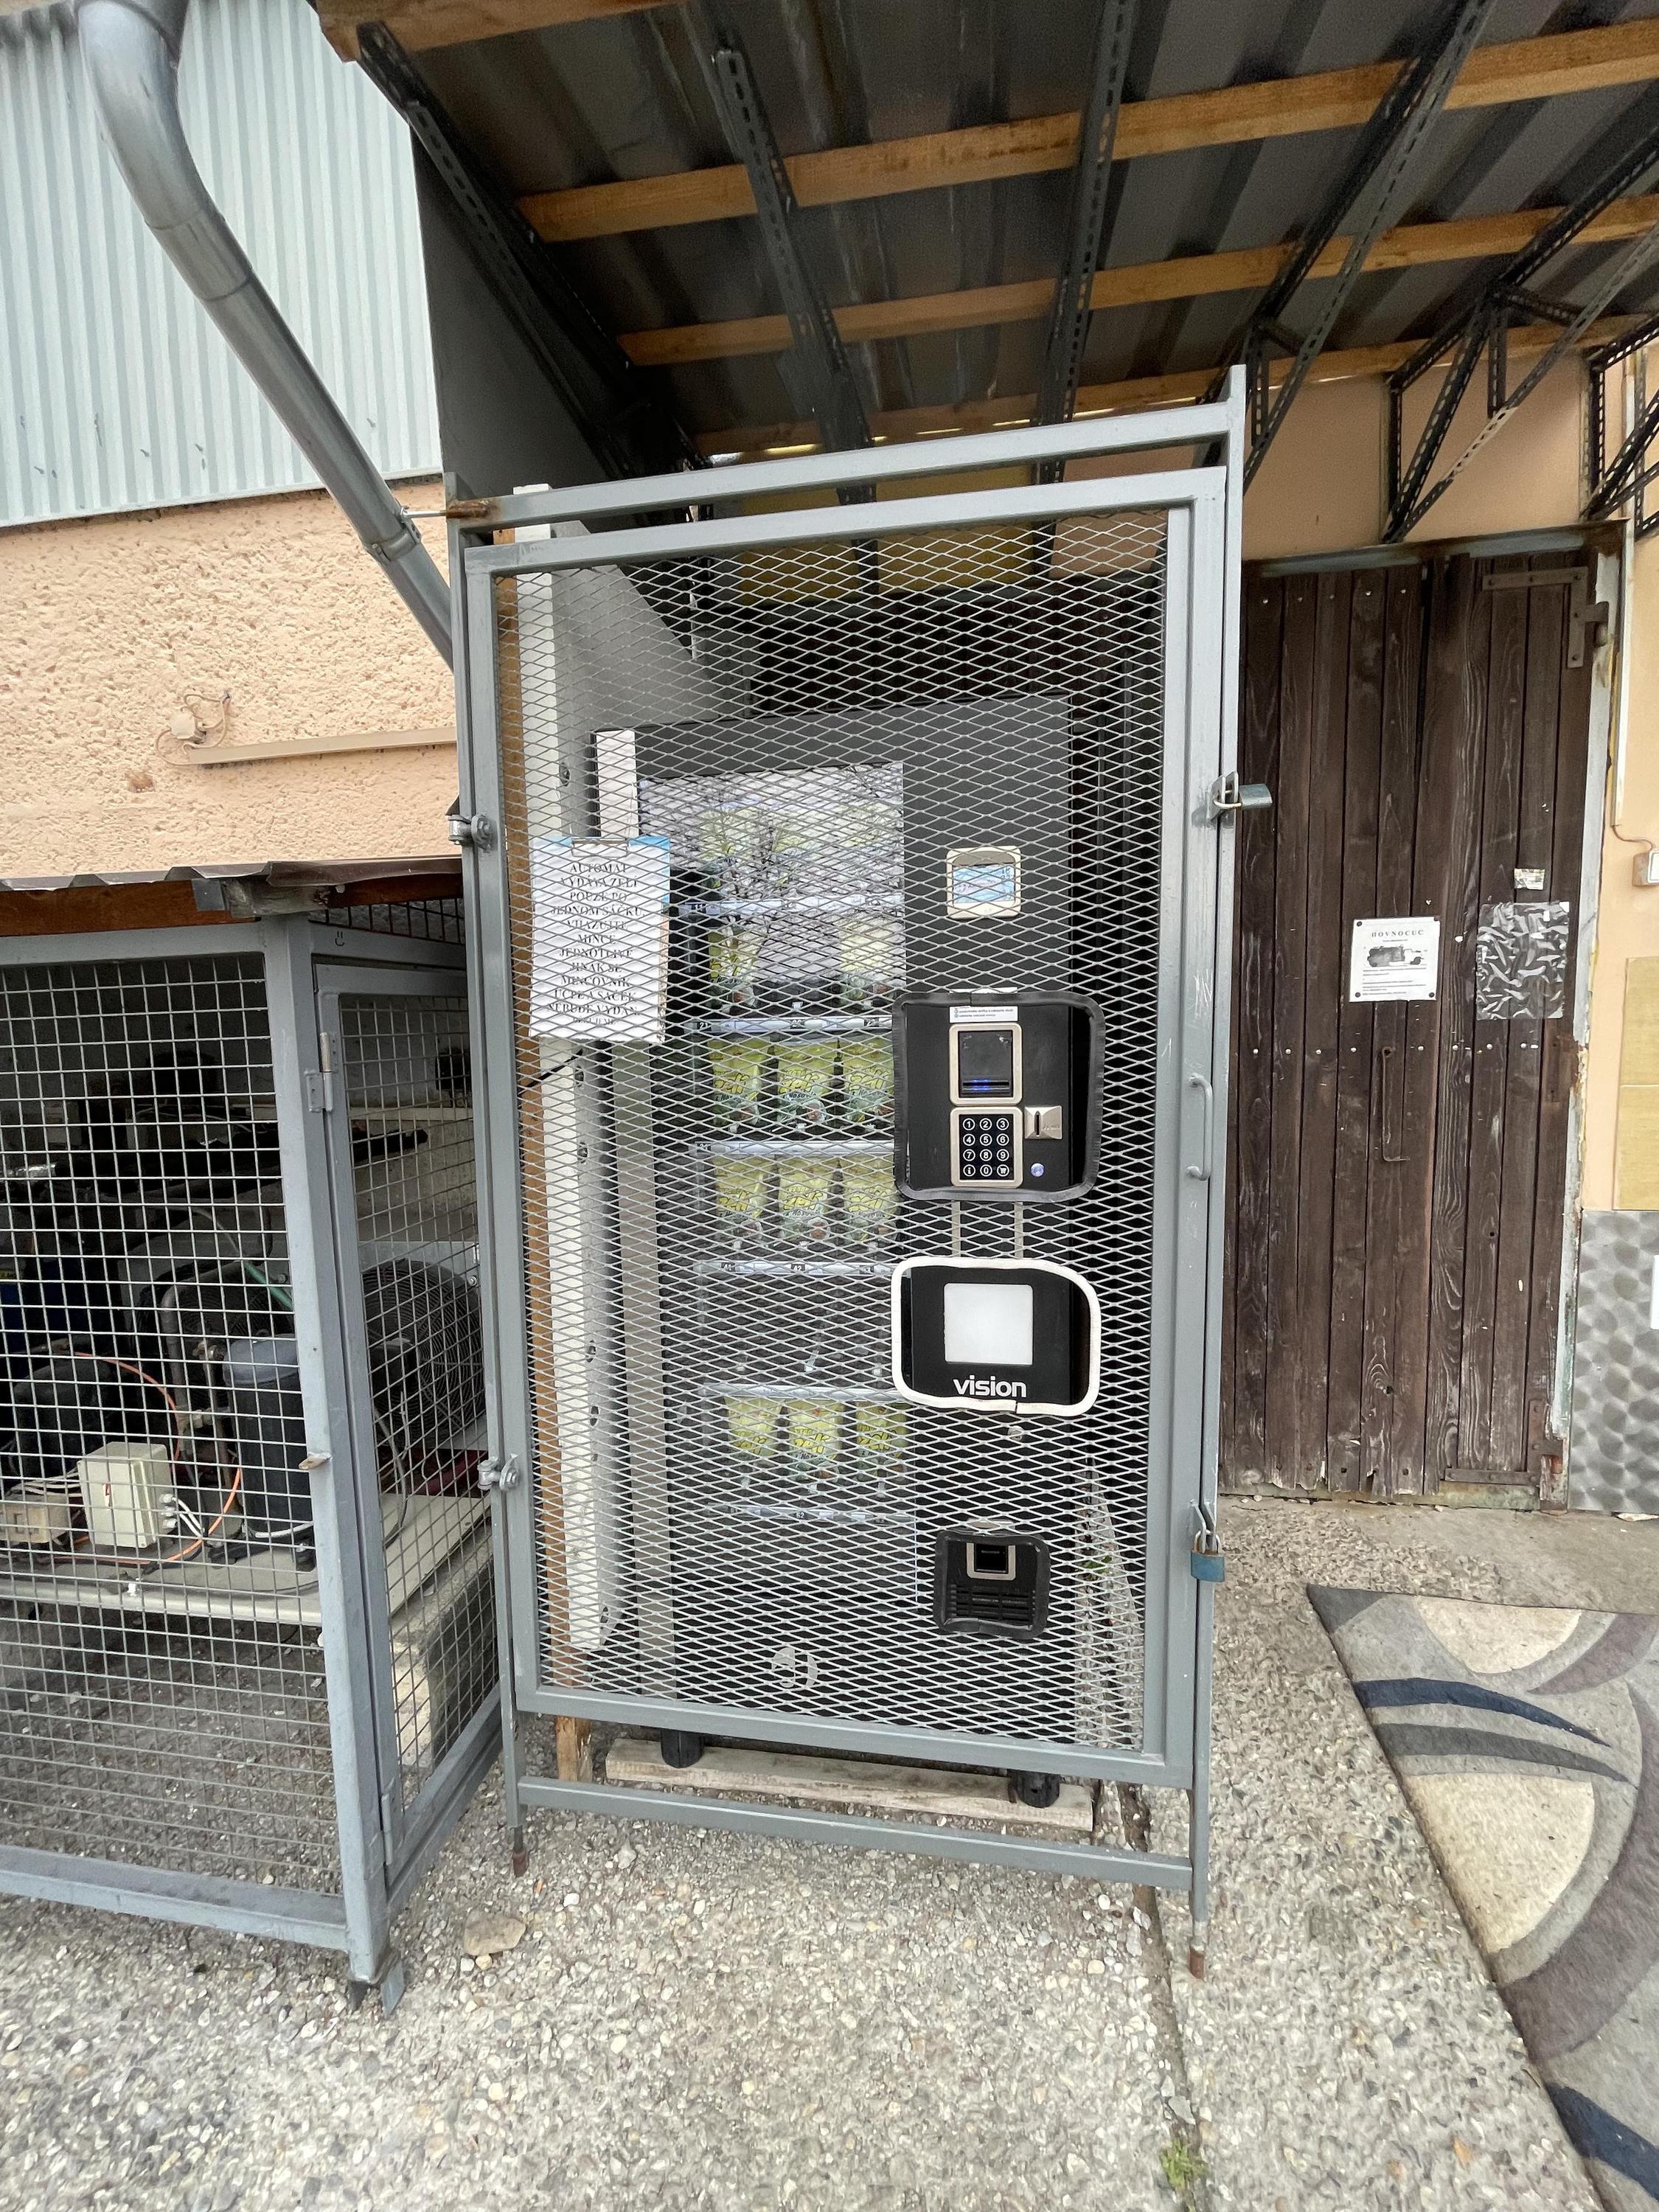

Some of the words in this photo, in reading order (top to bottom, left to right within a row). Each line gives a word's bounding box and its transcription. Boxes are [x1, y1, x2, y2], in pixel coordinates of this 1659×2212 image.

[570, 863, 627, 873] AUTOMAT
[570, 891, 608, 902] POUZE
[612, 891, 627, 902] PO
[551, 905, 599, 916] JEDNOM
[577, 934, 616, 945] MINCE
[953, 1374, 1027, 1398] vision
